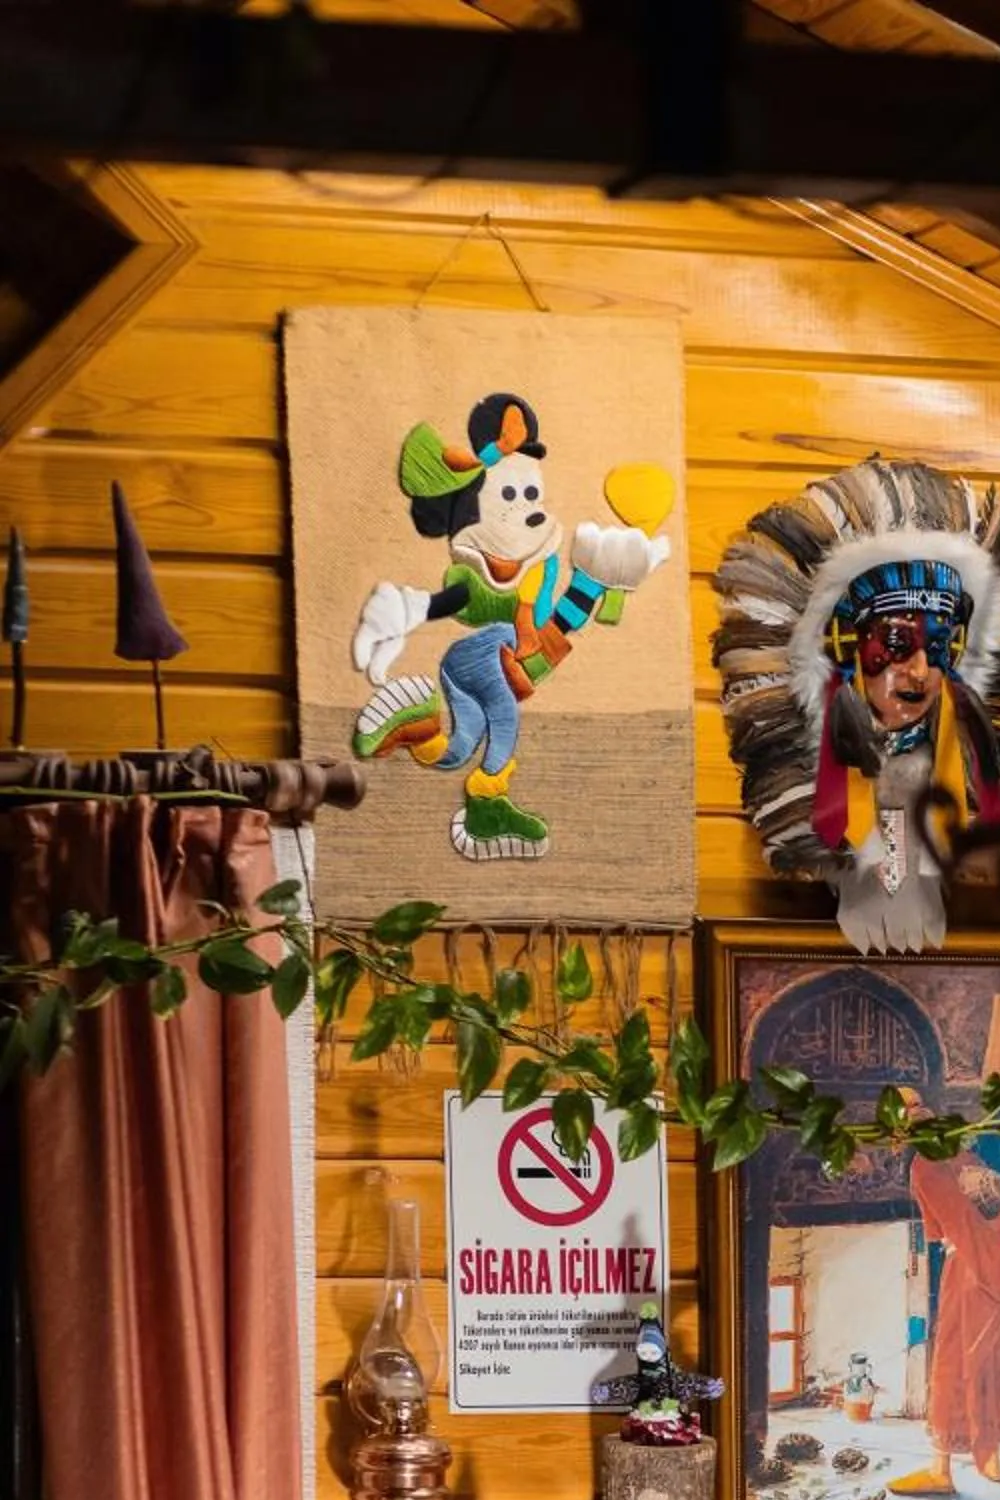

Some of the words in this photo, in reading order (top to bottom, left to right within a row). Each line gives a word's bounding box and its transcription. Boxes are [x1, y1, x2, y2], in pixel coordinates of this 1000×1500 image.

[459, 1238, 552, 1295] SİGARA
[559, 1238, 657, 1300] İÇİLMEZ
[459, 1341, 477, 1351] 4207
